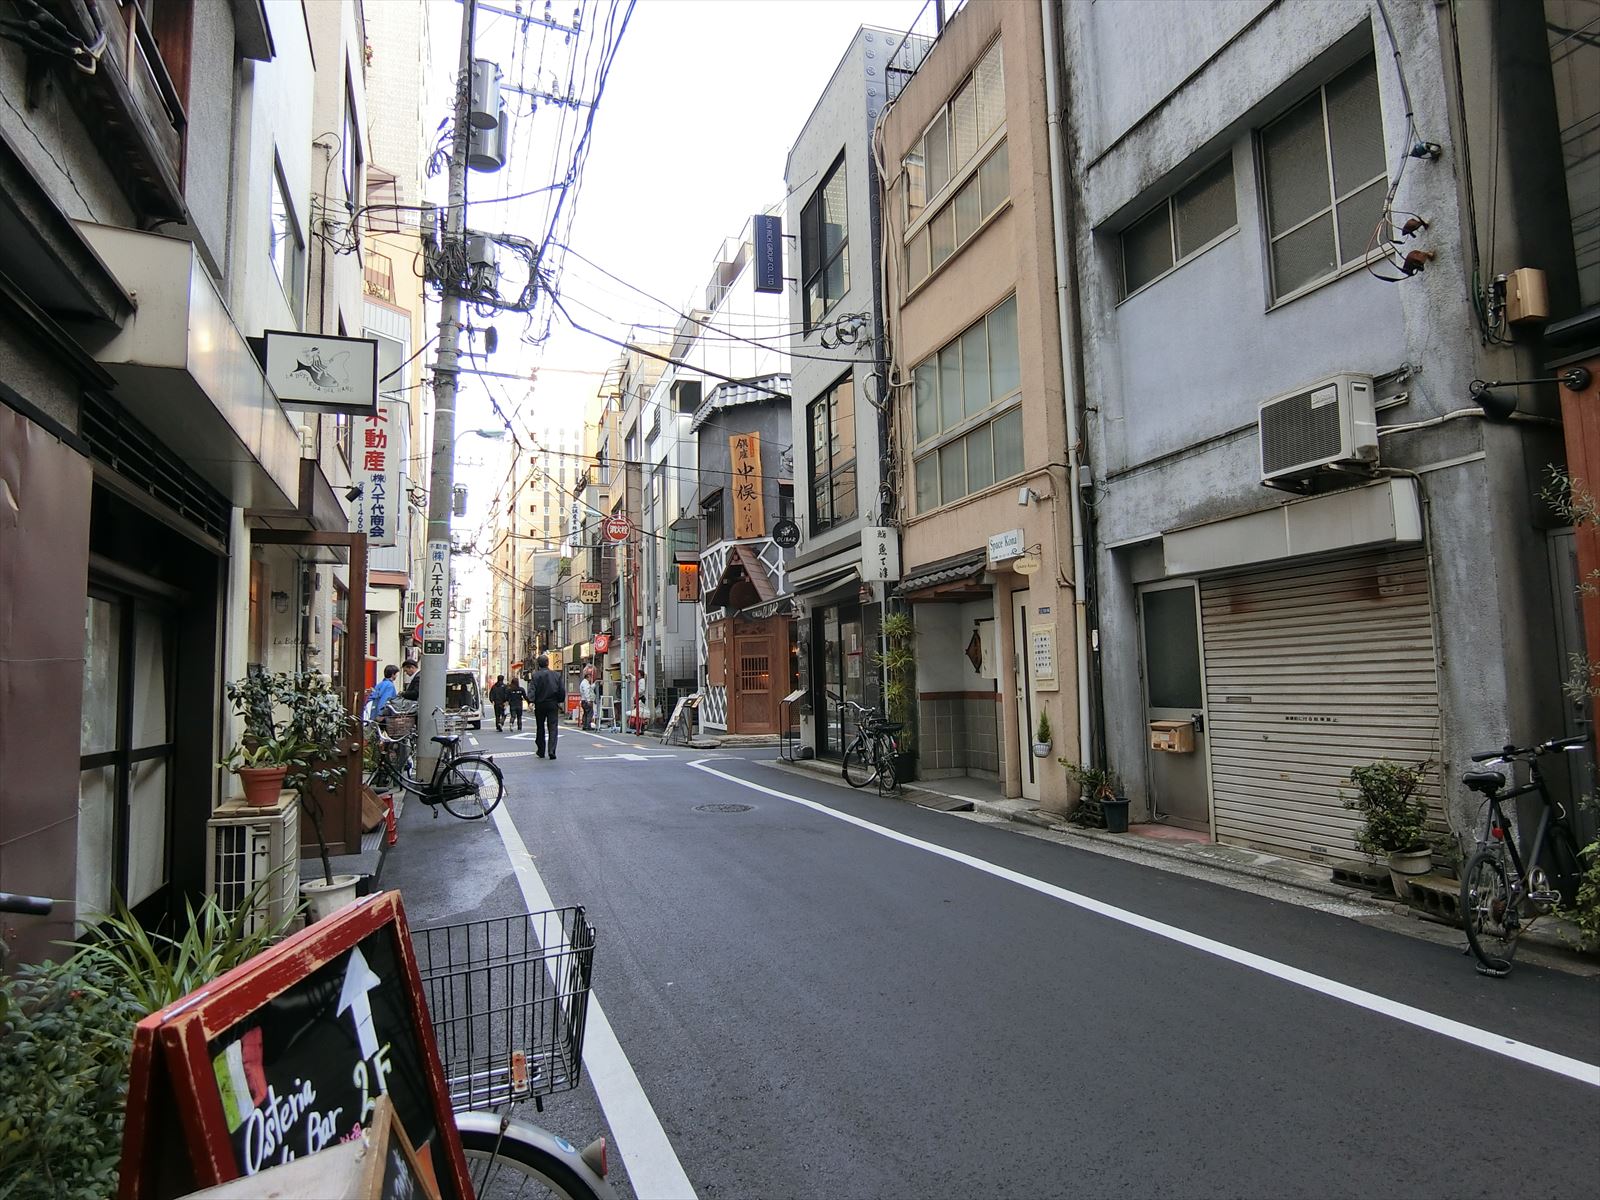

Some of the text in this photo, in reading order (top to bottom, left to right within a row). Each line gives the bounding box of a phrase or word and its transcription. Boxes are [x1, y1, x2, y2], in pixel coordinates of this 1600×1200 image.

[364, 408, 387, 471] 不動産
[245, 1078, 317, 1176] Osteria
[307, 1107, 344, 1155] Bar
